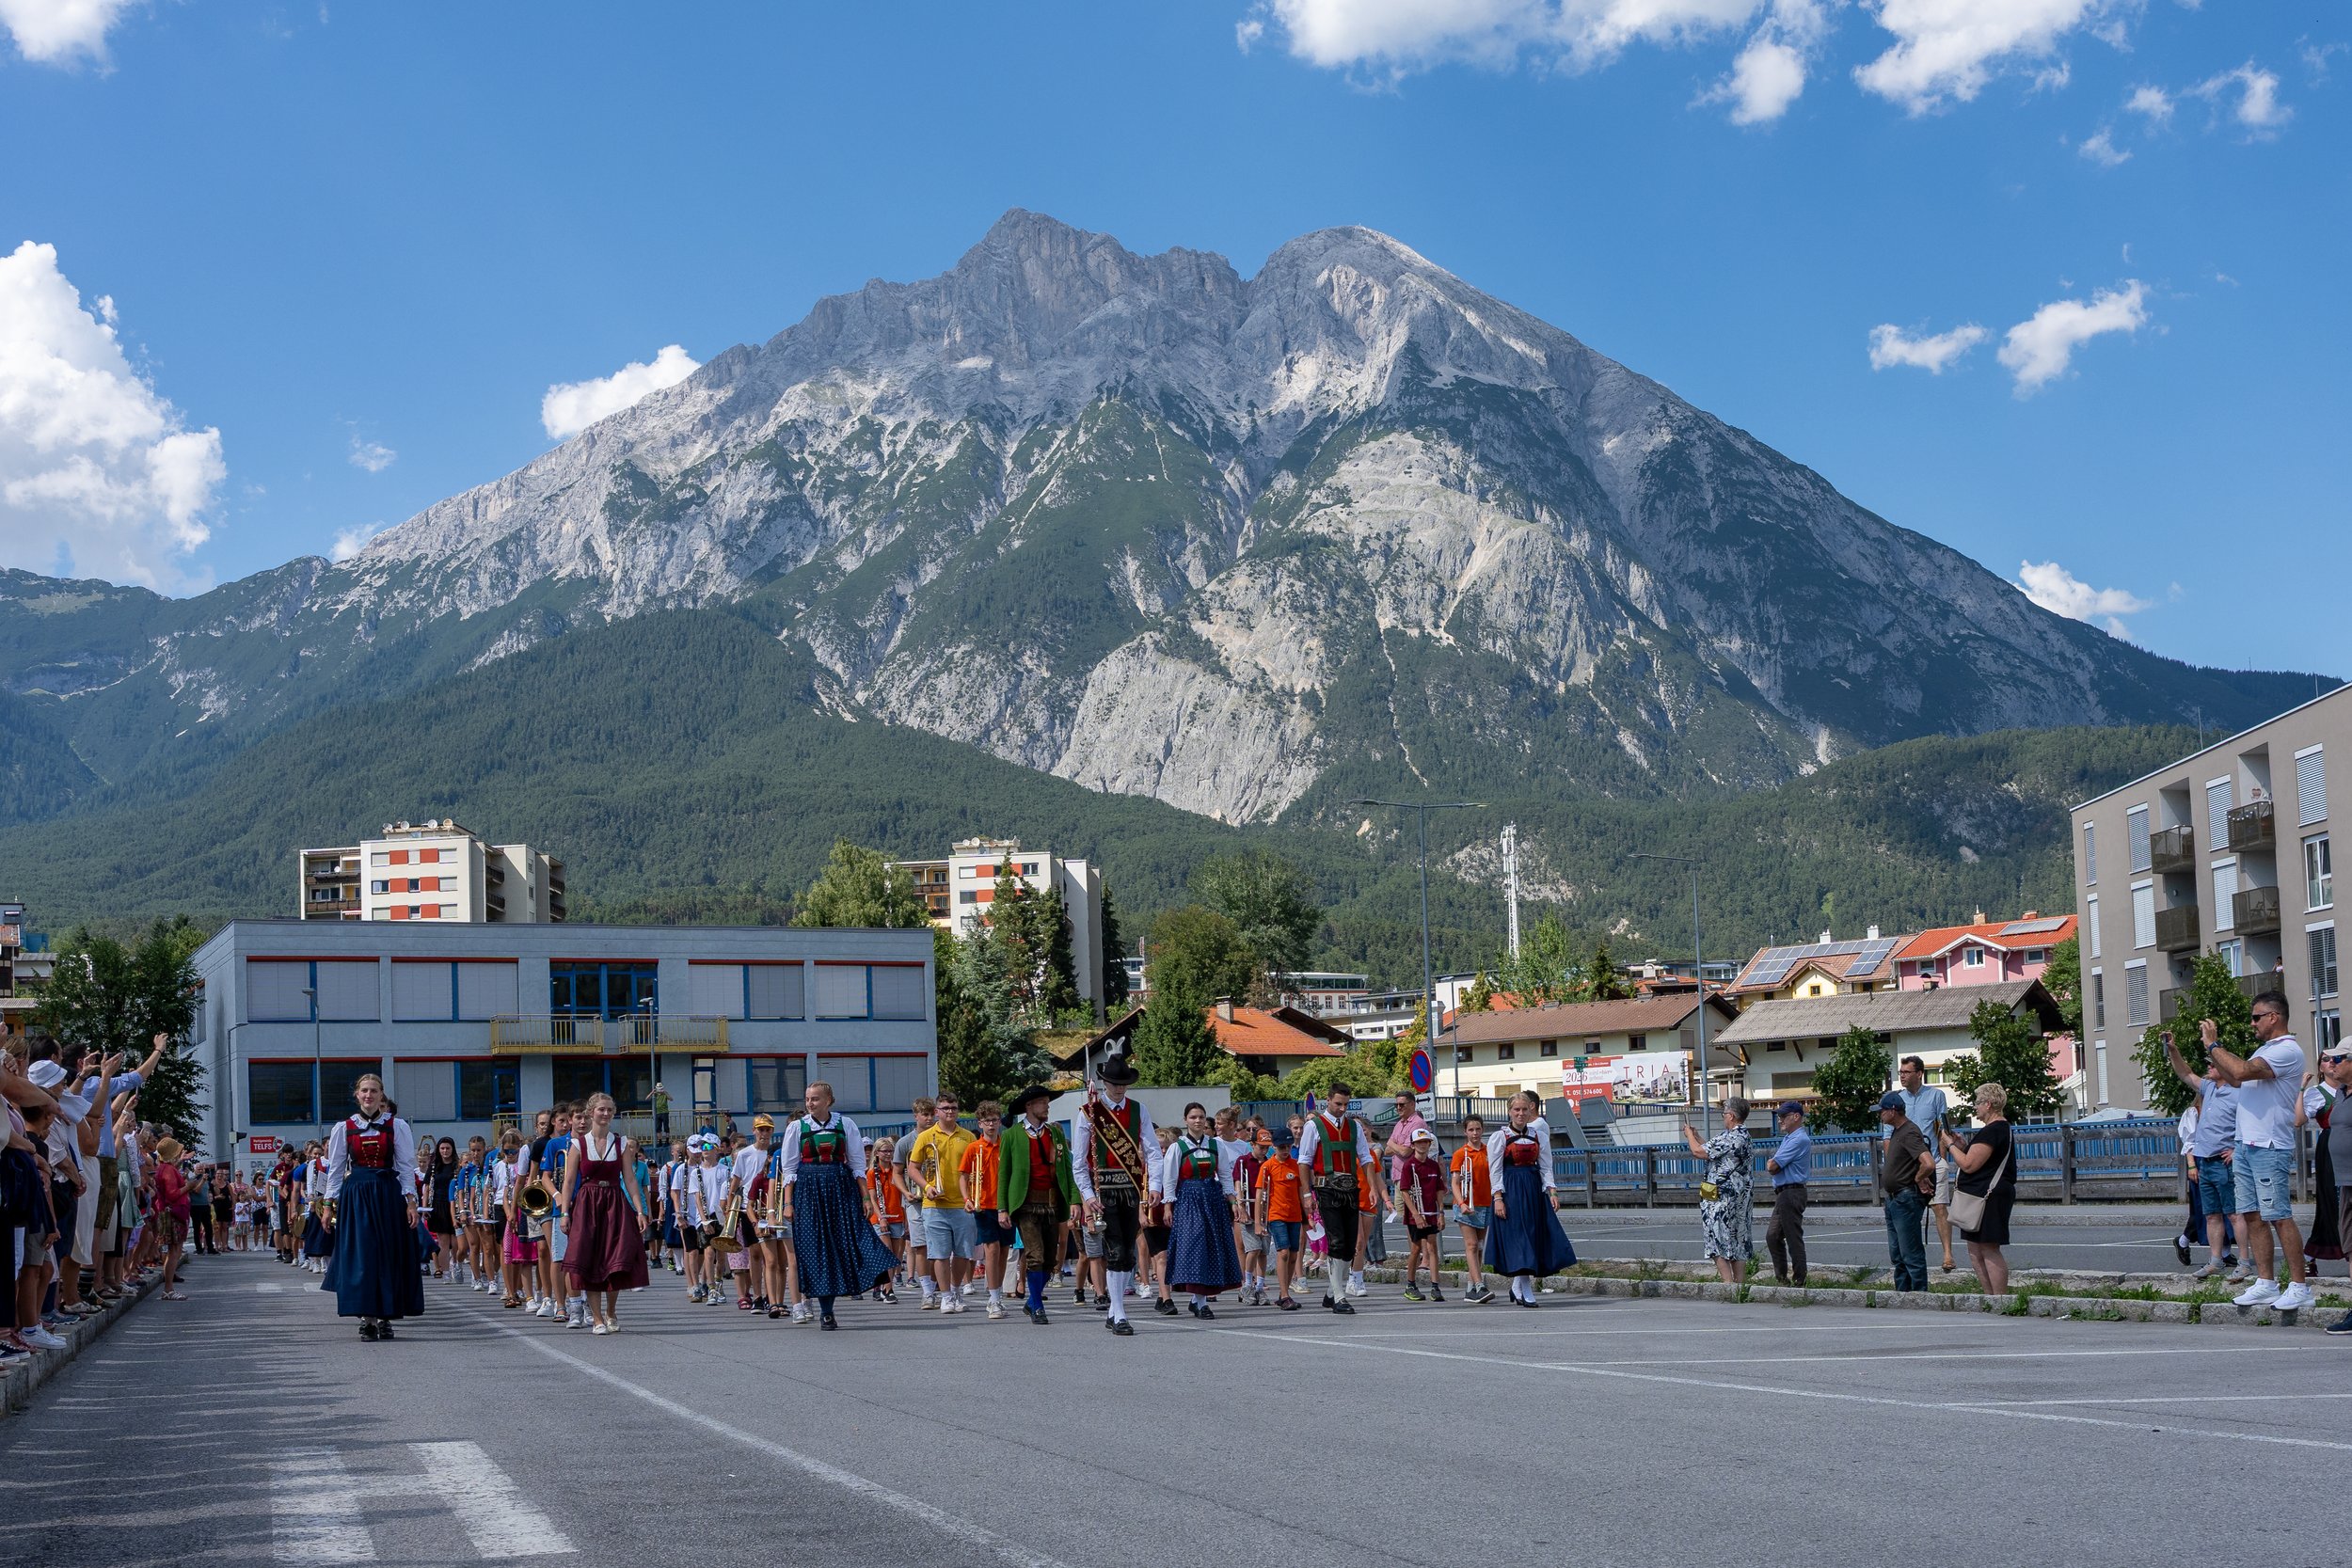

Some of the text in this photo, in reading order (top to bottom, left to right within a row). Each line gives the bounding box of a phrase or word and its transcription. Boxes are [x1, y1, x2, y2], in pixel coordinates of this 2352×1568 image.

[1565, 1071, 1588, 1083] 2026
[1623, 1064, 1670, 1080] TRIA
[1347, 1101, 1361, 1110] 189
[1376, 1110, 1393, 1121] BLEIB
